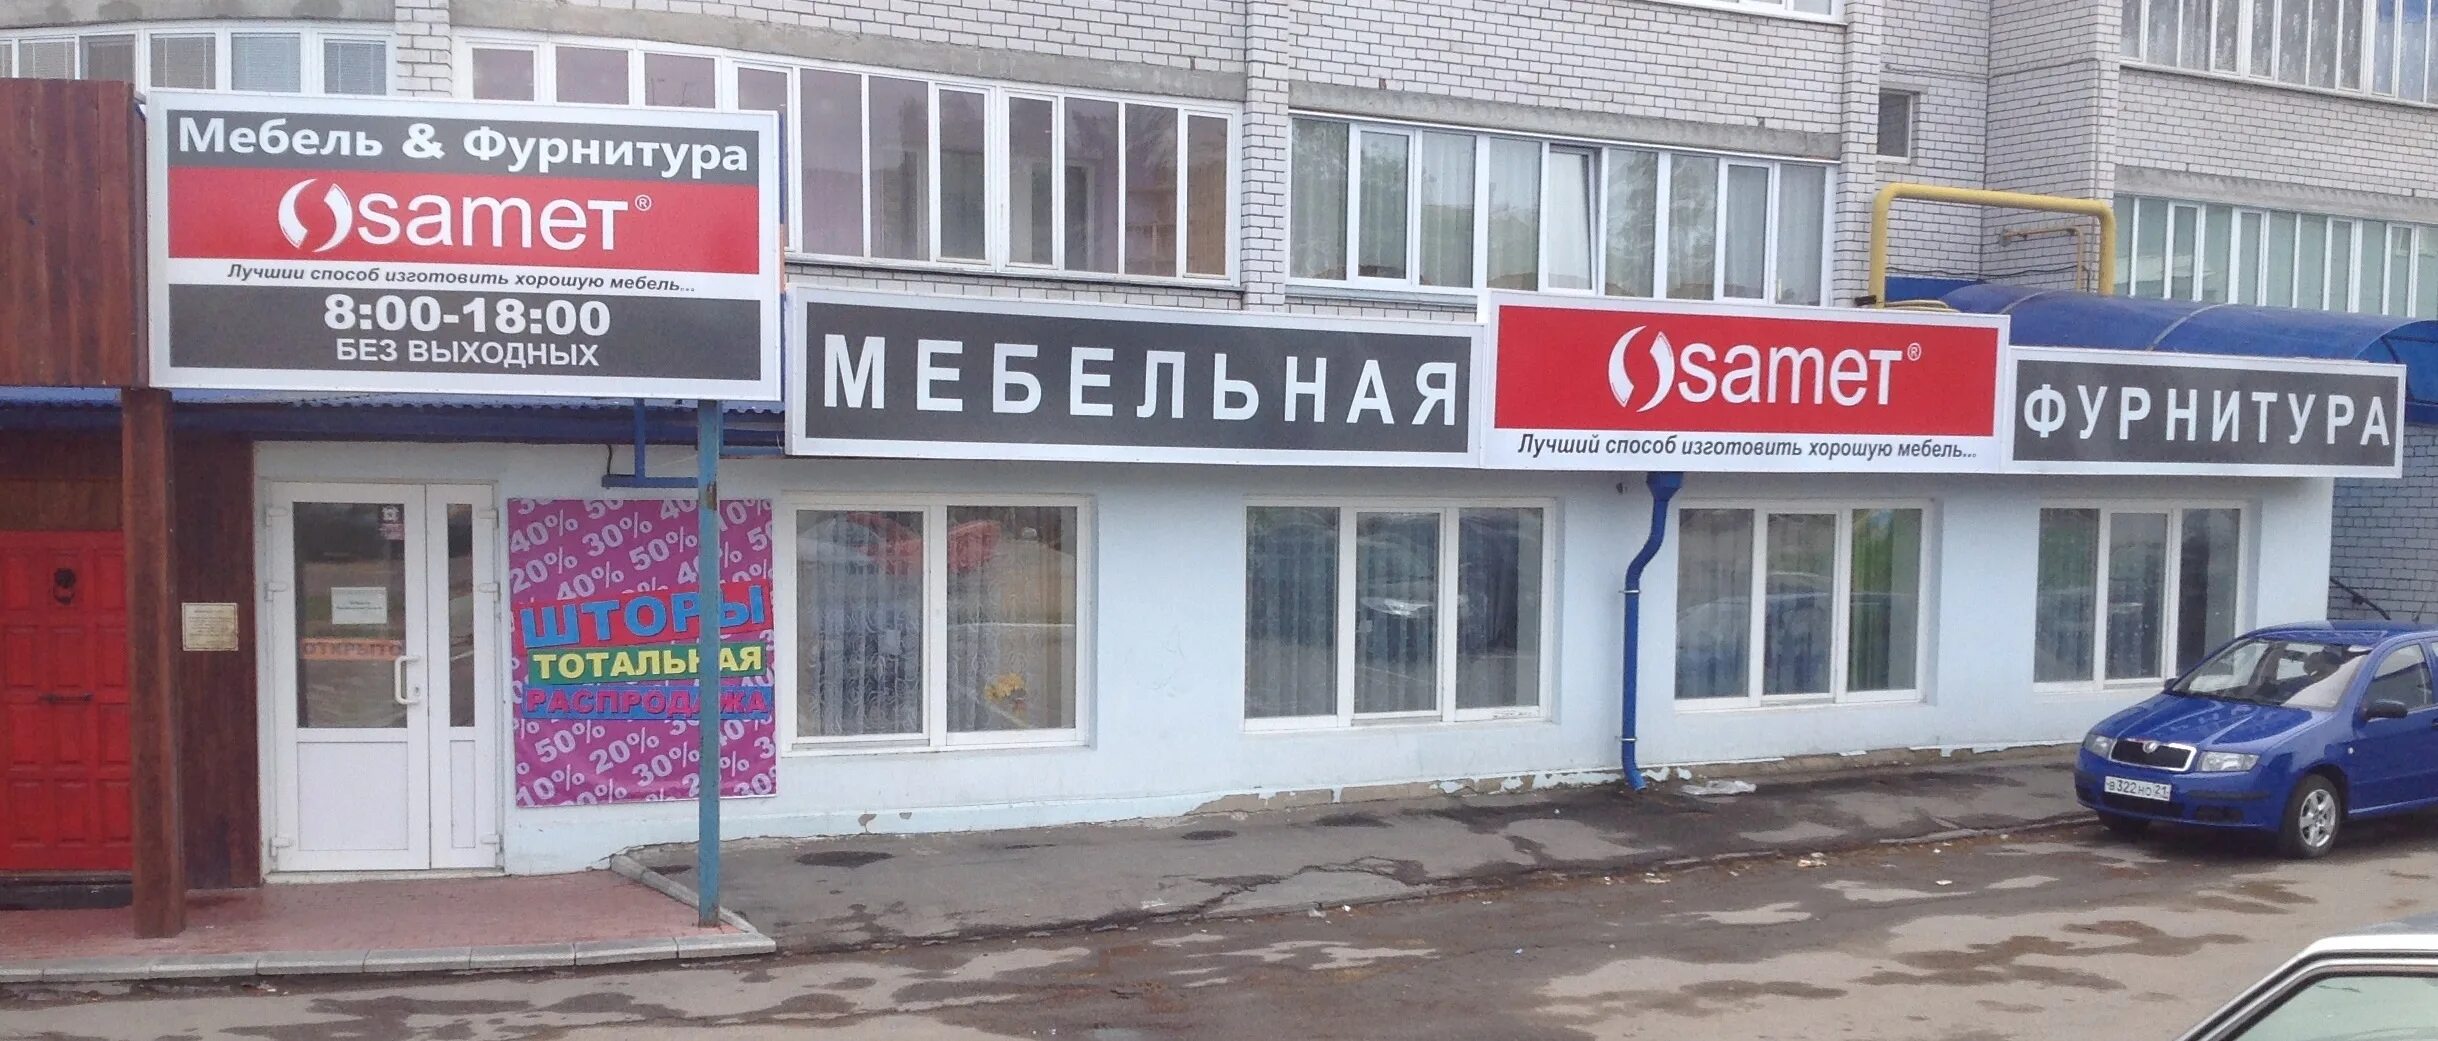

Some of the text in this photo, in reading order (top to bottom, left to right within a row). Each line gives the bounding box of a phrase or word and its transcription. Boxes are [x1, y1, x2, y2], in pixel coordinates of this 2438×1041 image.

[178, 117, 750, 179] Мебель & Фурнитура
[310, 267, 380, 282] способ
[385, 270, 509, 285] изготовить
[515, 273, 604, 291] хорошую
[324, 293, 611, 336] 8:00-18:00
[336, 338, 600, 369] БЕЗ ВЫХОДНЫХ
[823, 334, 1457, 426] МЕБЕЛЬНАЯ
[2023, 383, 2390, 446] ФУРНИТУРА
[1517, 433, 1600, 458] Лучший
[1605, 434, 1677, 455] способ
[1682, 439, 1803, 456] изготовить
[1808, 441, 1892, 461] хорошую
[510, 509, 578, 553] 40%
[582, 511, 653, 557] 30%
[629, 526, 698, 571] 50%
[510, 546, 578, 594] 20%
[557, 561, 625, 600] 40%
[526, 688, 769, 718] РАСПРОДЖА
[535, 720, 605, 763] 50%
[589, 726, 660, 775] 20%
[632, 741, 700, 787] 30%
